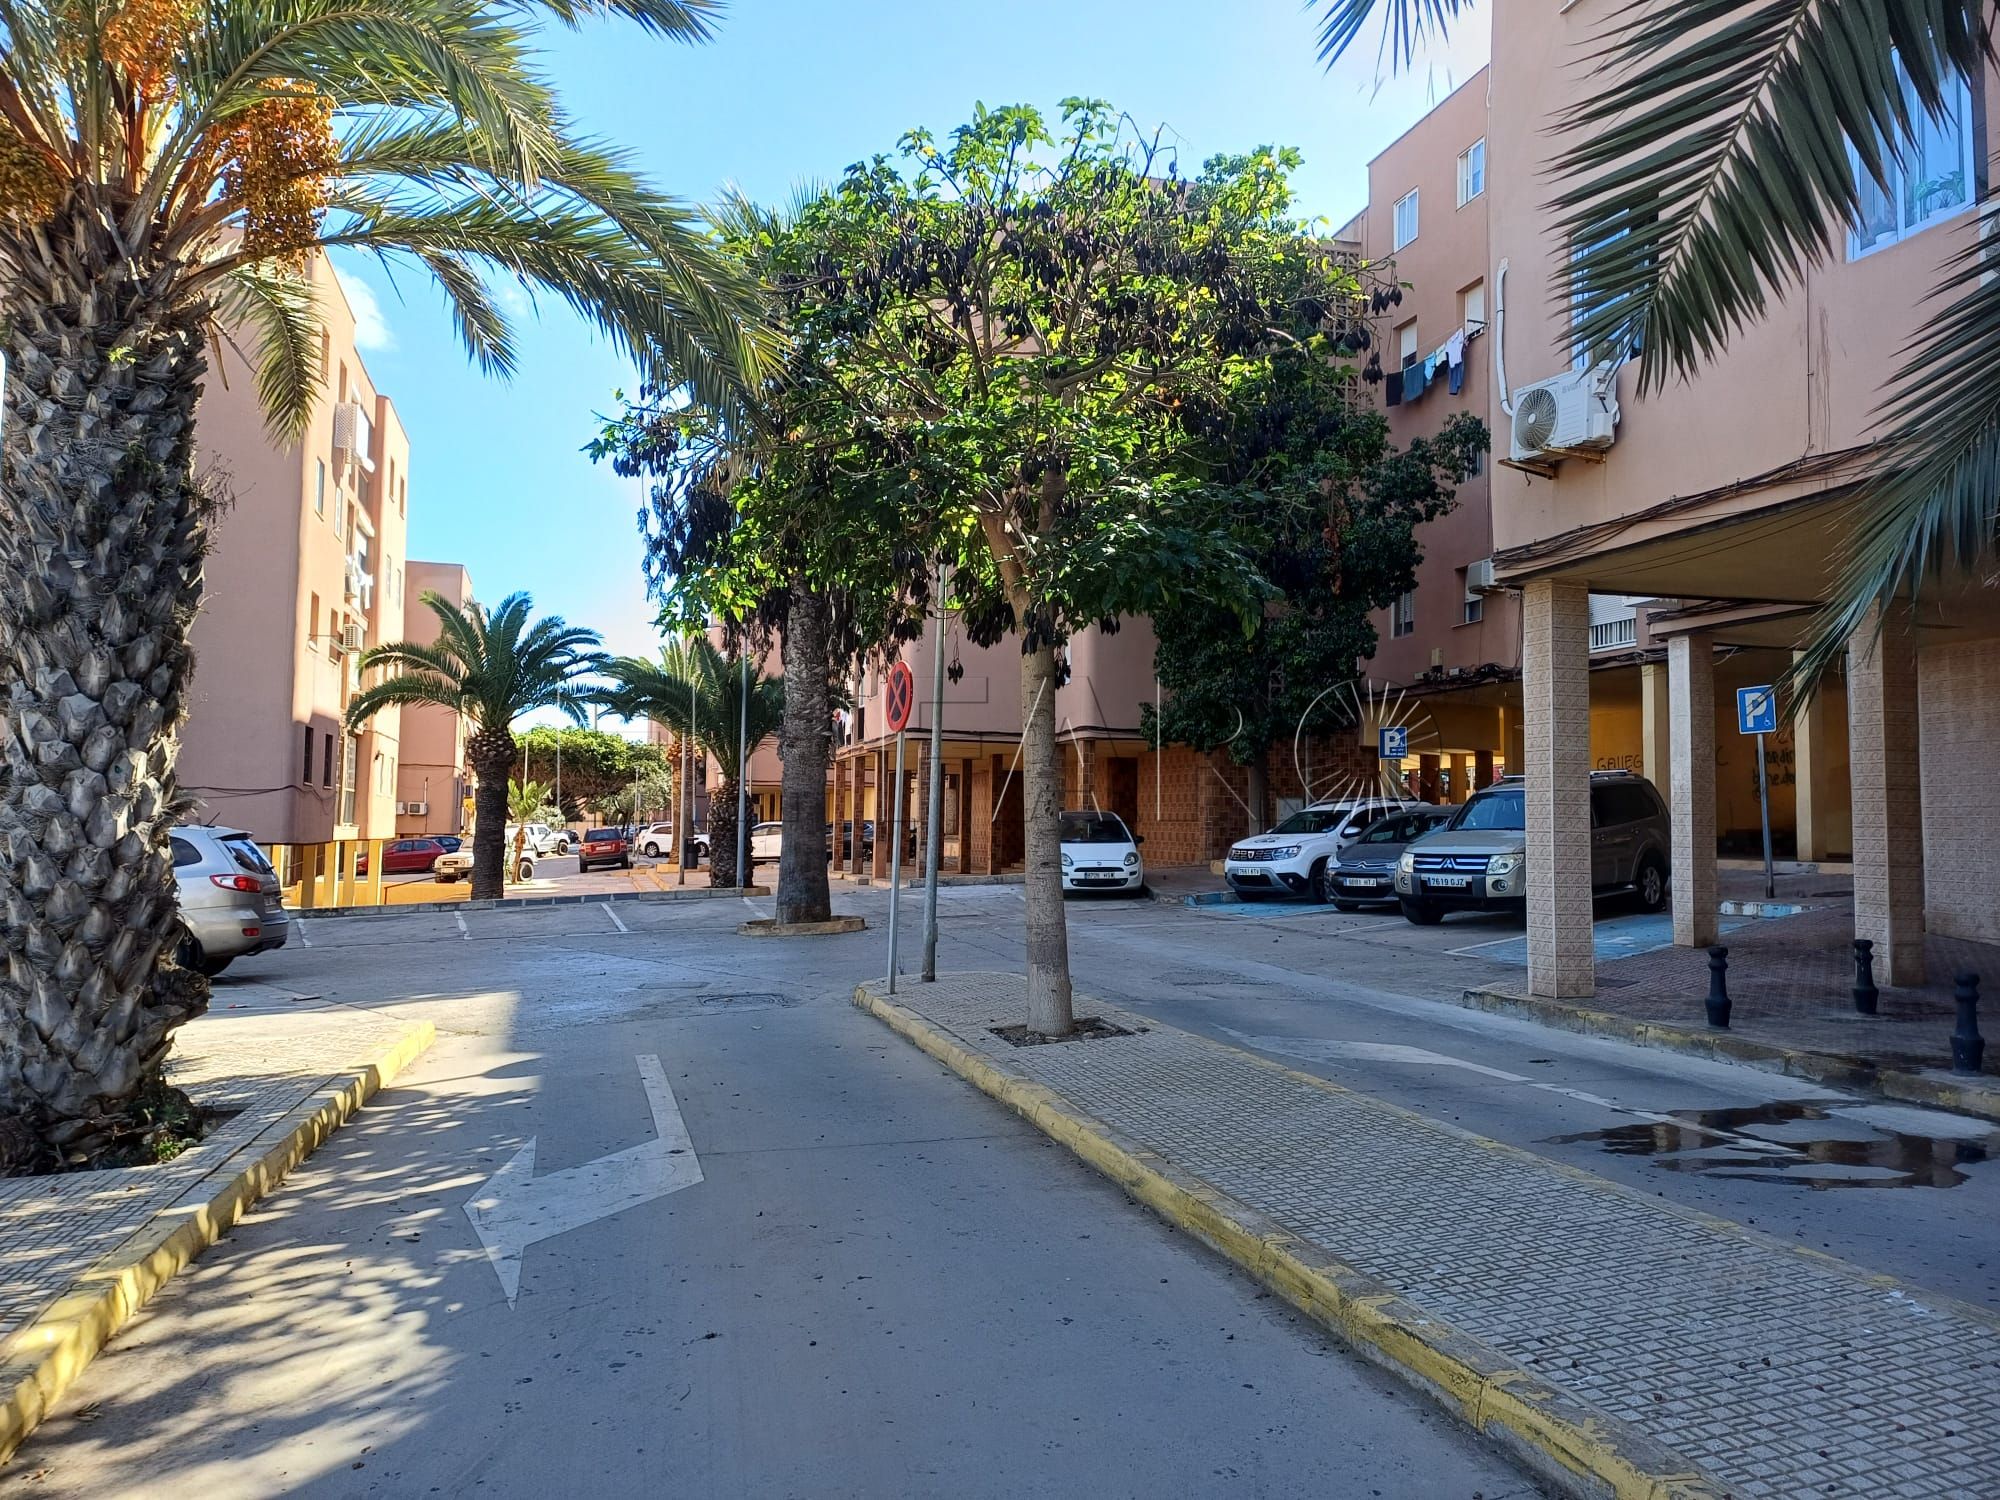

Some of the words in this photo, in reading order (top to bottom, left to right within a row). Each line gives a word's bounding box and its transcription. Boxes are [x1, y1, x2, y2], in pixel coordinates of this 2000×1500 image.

[1745, 692, 1767, 728] P
[1384, 731, 1400, 756] P
[1431, 878, 1449, 886] 7619
